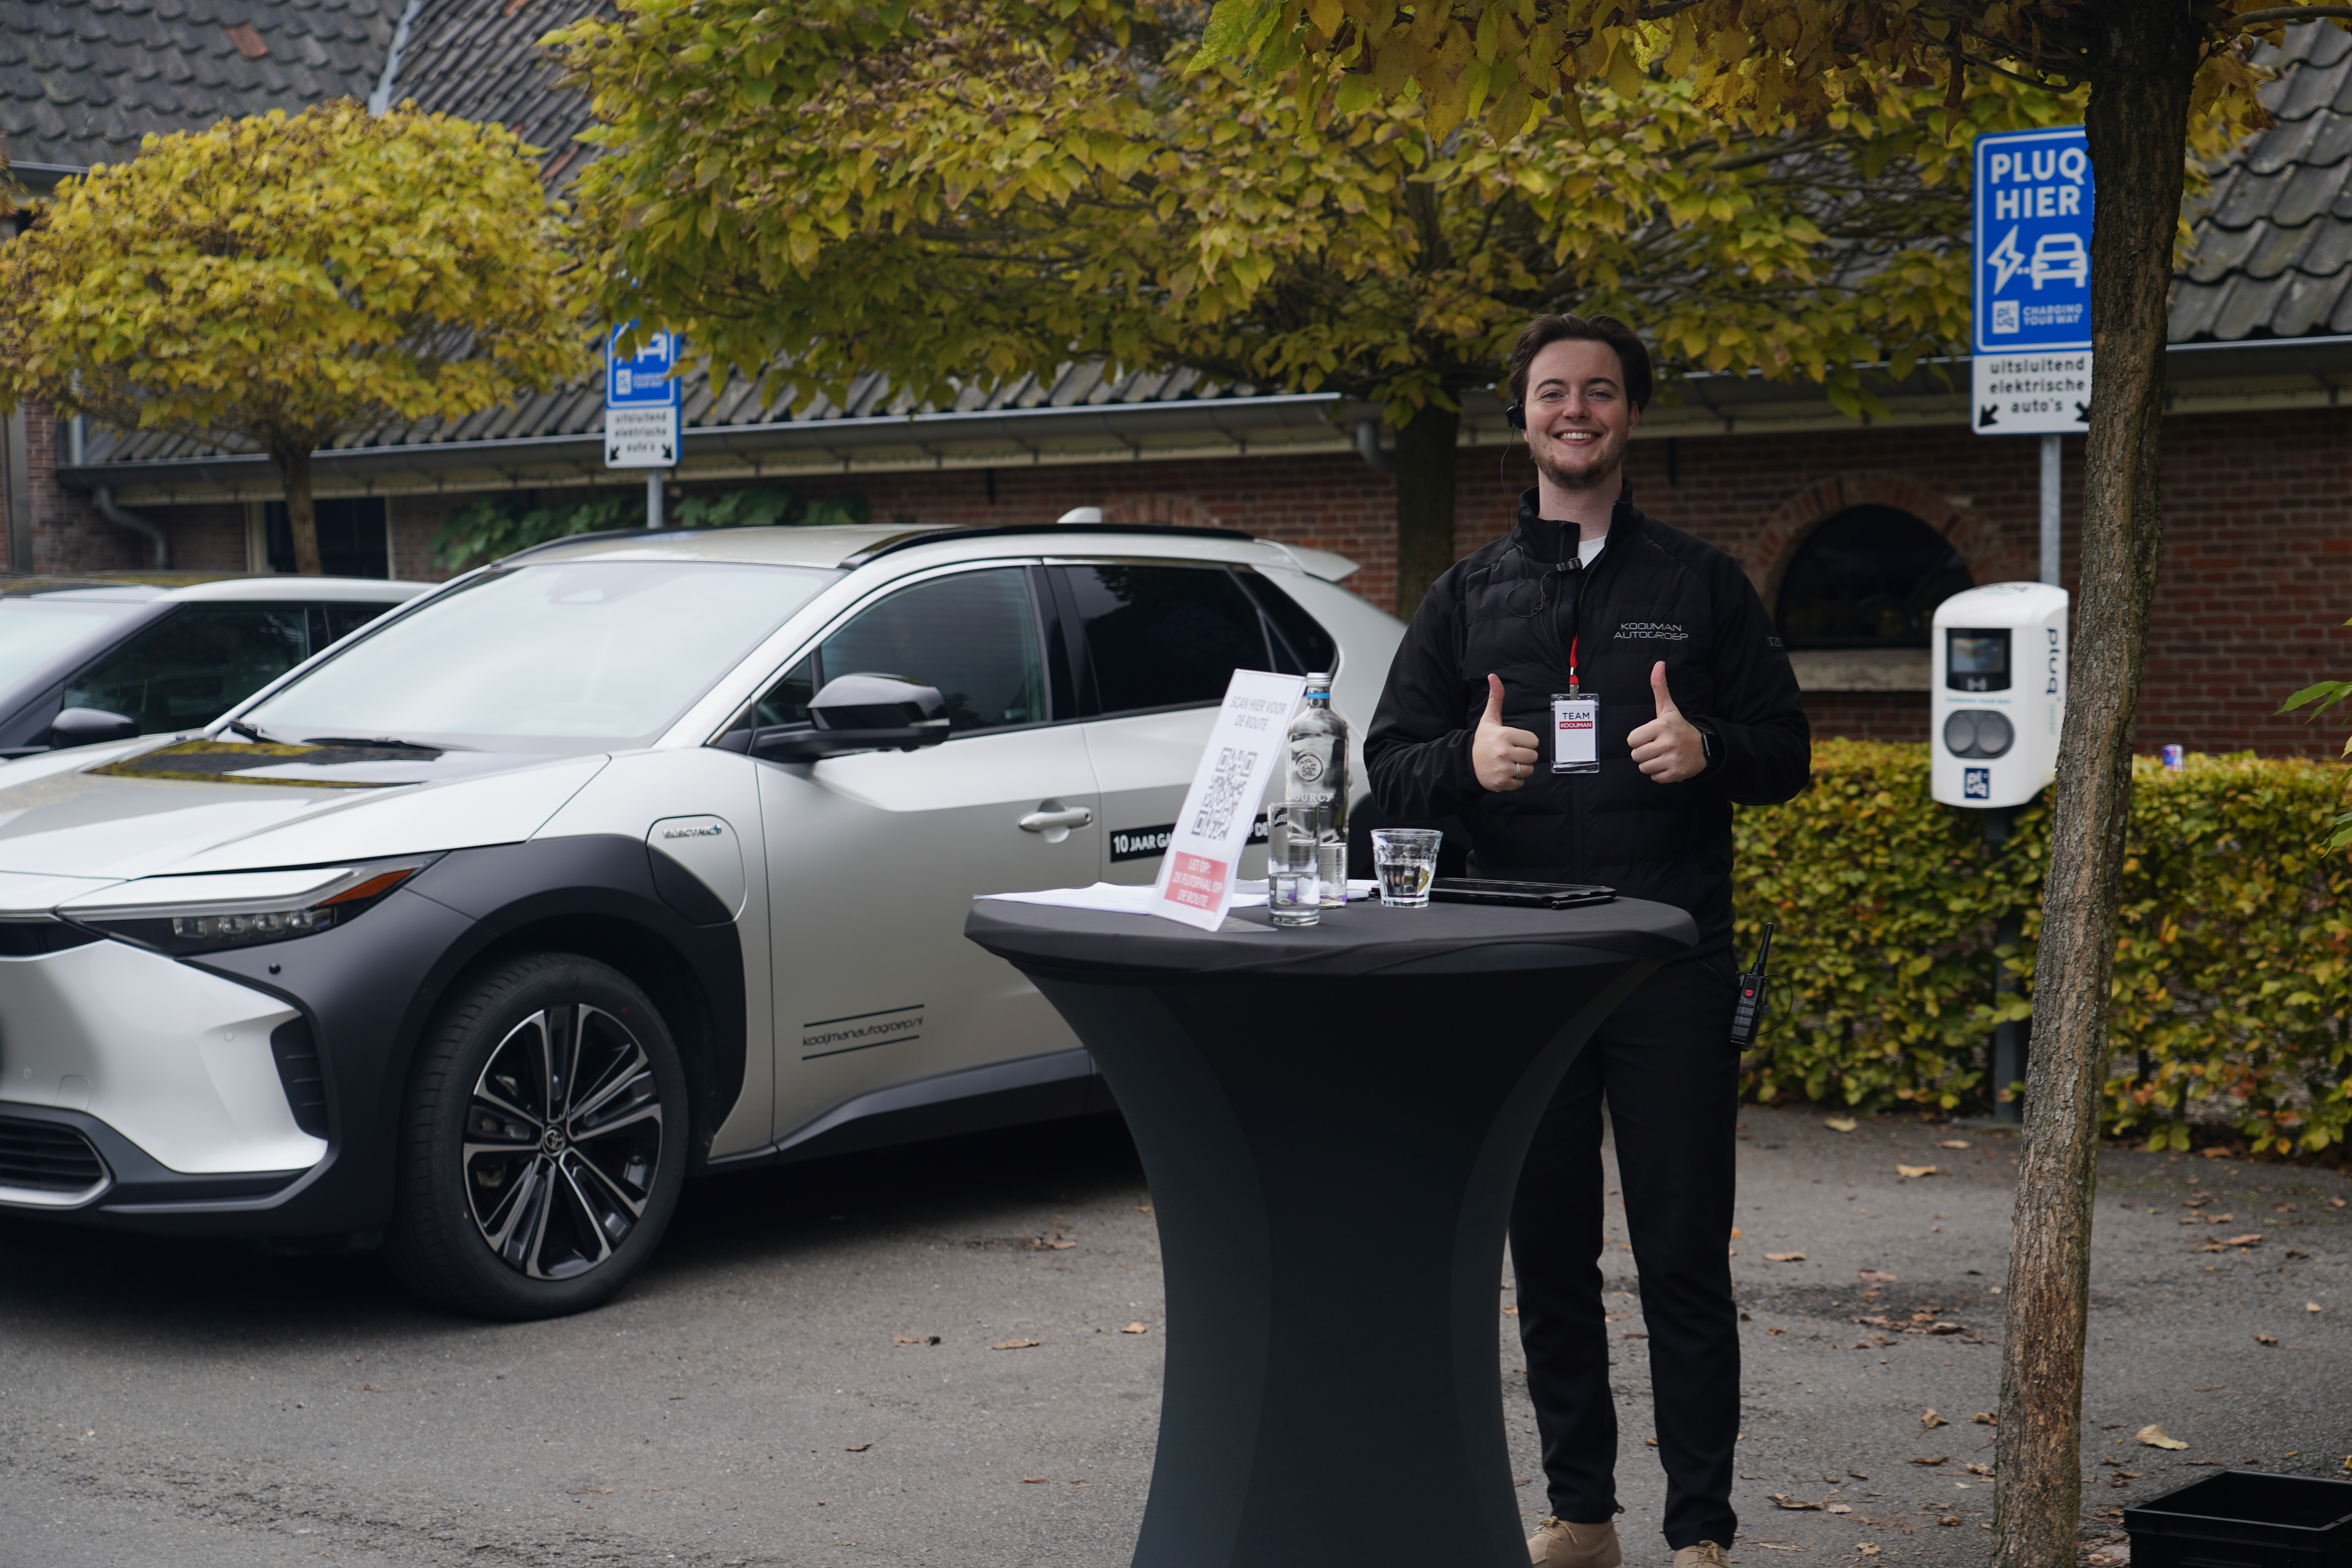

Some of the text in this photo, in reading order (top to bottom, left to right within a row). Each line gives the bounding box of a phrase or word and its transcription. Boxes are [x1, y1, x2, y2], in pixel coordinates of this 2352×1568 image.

[1991, 147, 2087, 185] PLUQ
[1996, 185, 2080, 220] HIER
[2023, 303, 2083, 315] CHARGING
[2024, 314, 2081, 326] YOUR WAY
[1991, 357, 2084, 373] uitsluitend
[1991, 377, 2084, 393] elektrische
[2012, 397, 2062, 412] auto's
[1621, 623, 1682, 631] KOOIJMAN
[1613, 632, 1688, 640] AUTOGROEP
[2046, 629, 2060, 694] pluq
[1230, 696, 1287, 715] SCAN HIER VOOR
[1235, 715, 1269, 730] DE ROUTE
[1289, 793, 1334, 802] OURCY
[1113, 834, 1129, 853] 10
[1129, 835, 1156, 852] JAAR
[1189, 858, 1200, 871] LET
[1173, 871, 1222, 893] 2X FLITSPAAL OP
[1177, 889, 1209, 907] DE ROUTE
